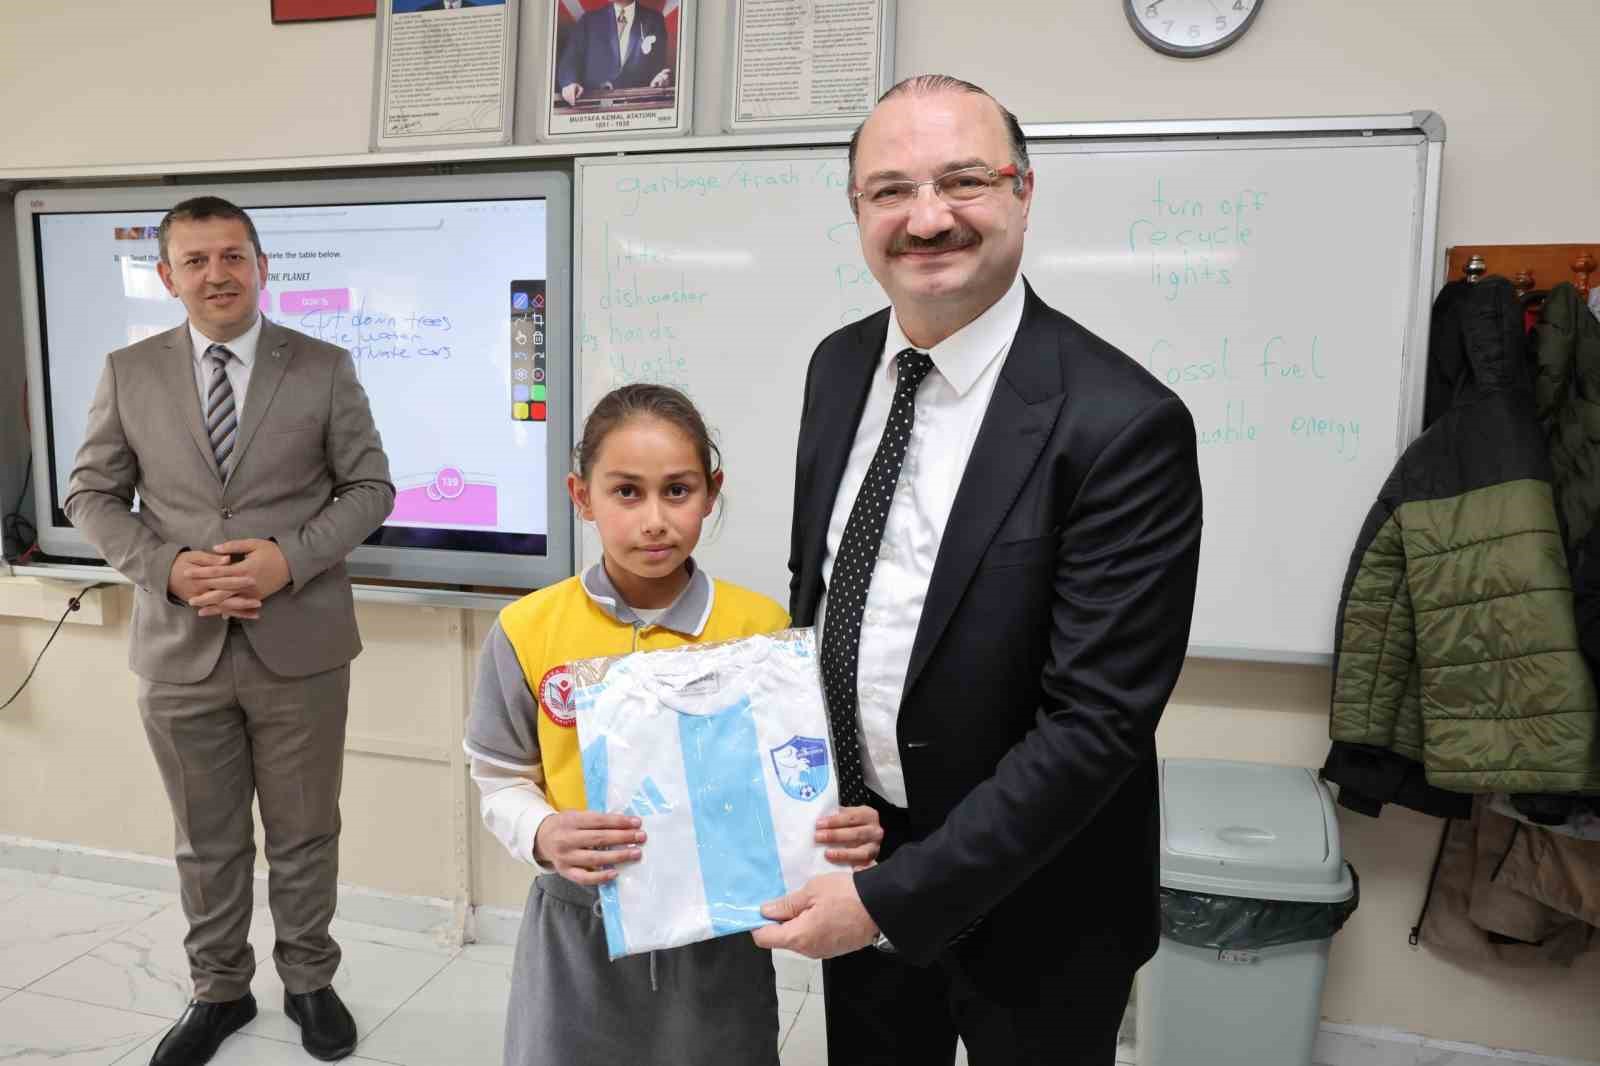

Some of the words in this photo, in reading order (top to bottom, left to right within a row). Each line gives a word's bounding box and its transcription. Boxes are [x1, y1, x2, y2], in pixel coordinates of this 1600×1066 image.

[1161, 20, 1175, 34] 7
[1215, 15, 1227, 30] 5
[1188, 24, 1200, 39] 6
[1152, 176, 1203, 216] turn
[282, 272, 310, 281] PLANET
[1151, 248, 1232, 301] lights
[1290, 416, 1361, 463] energy
